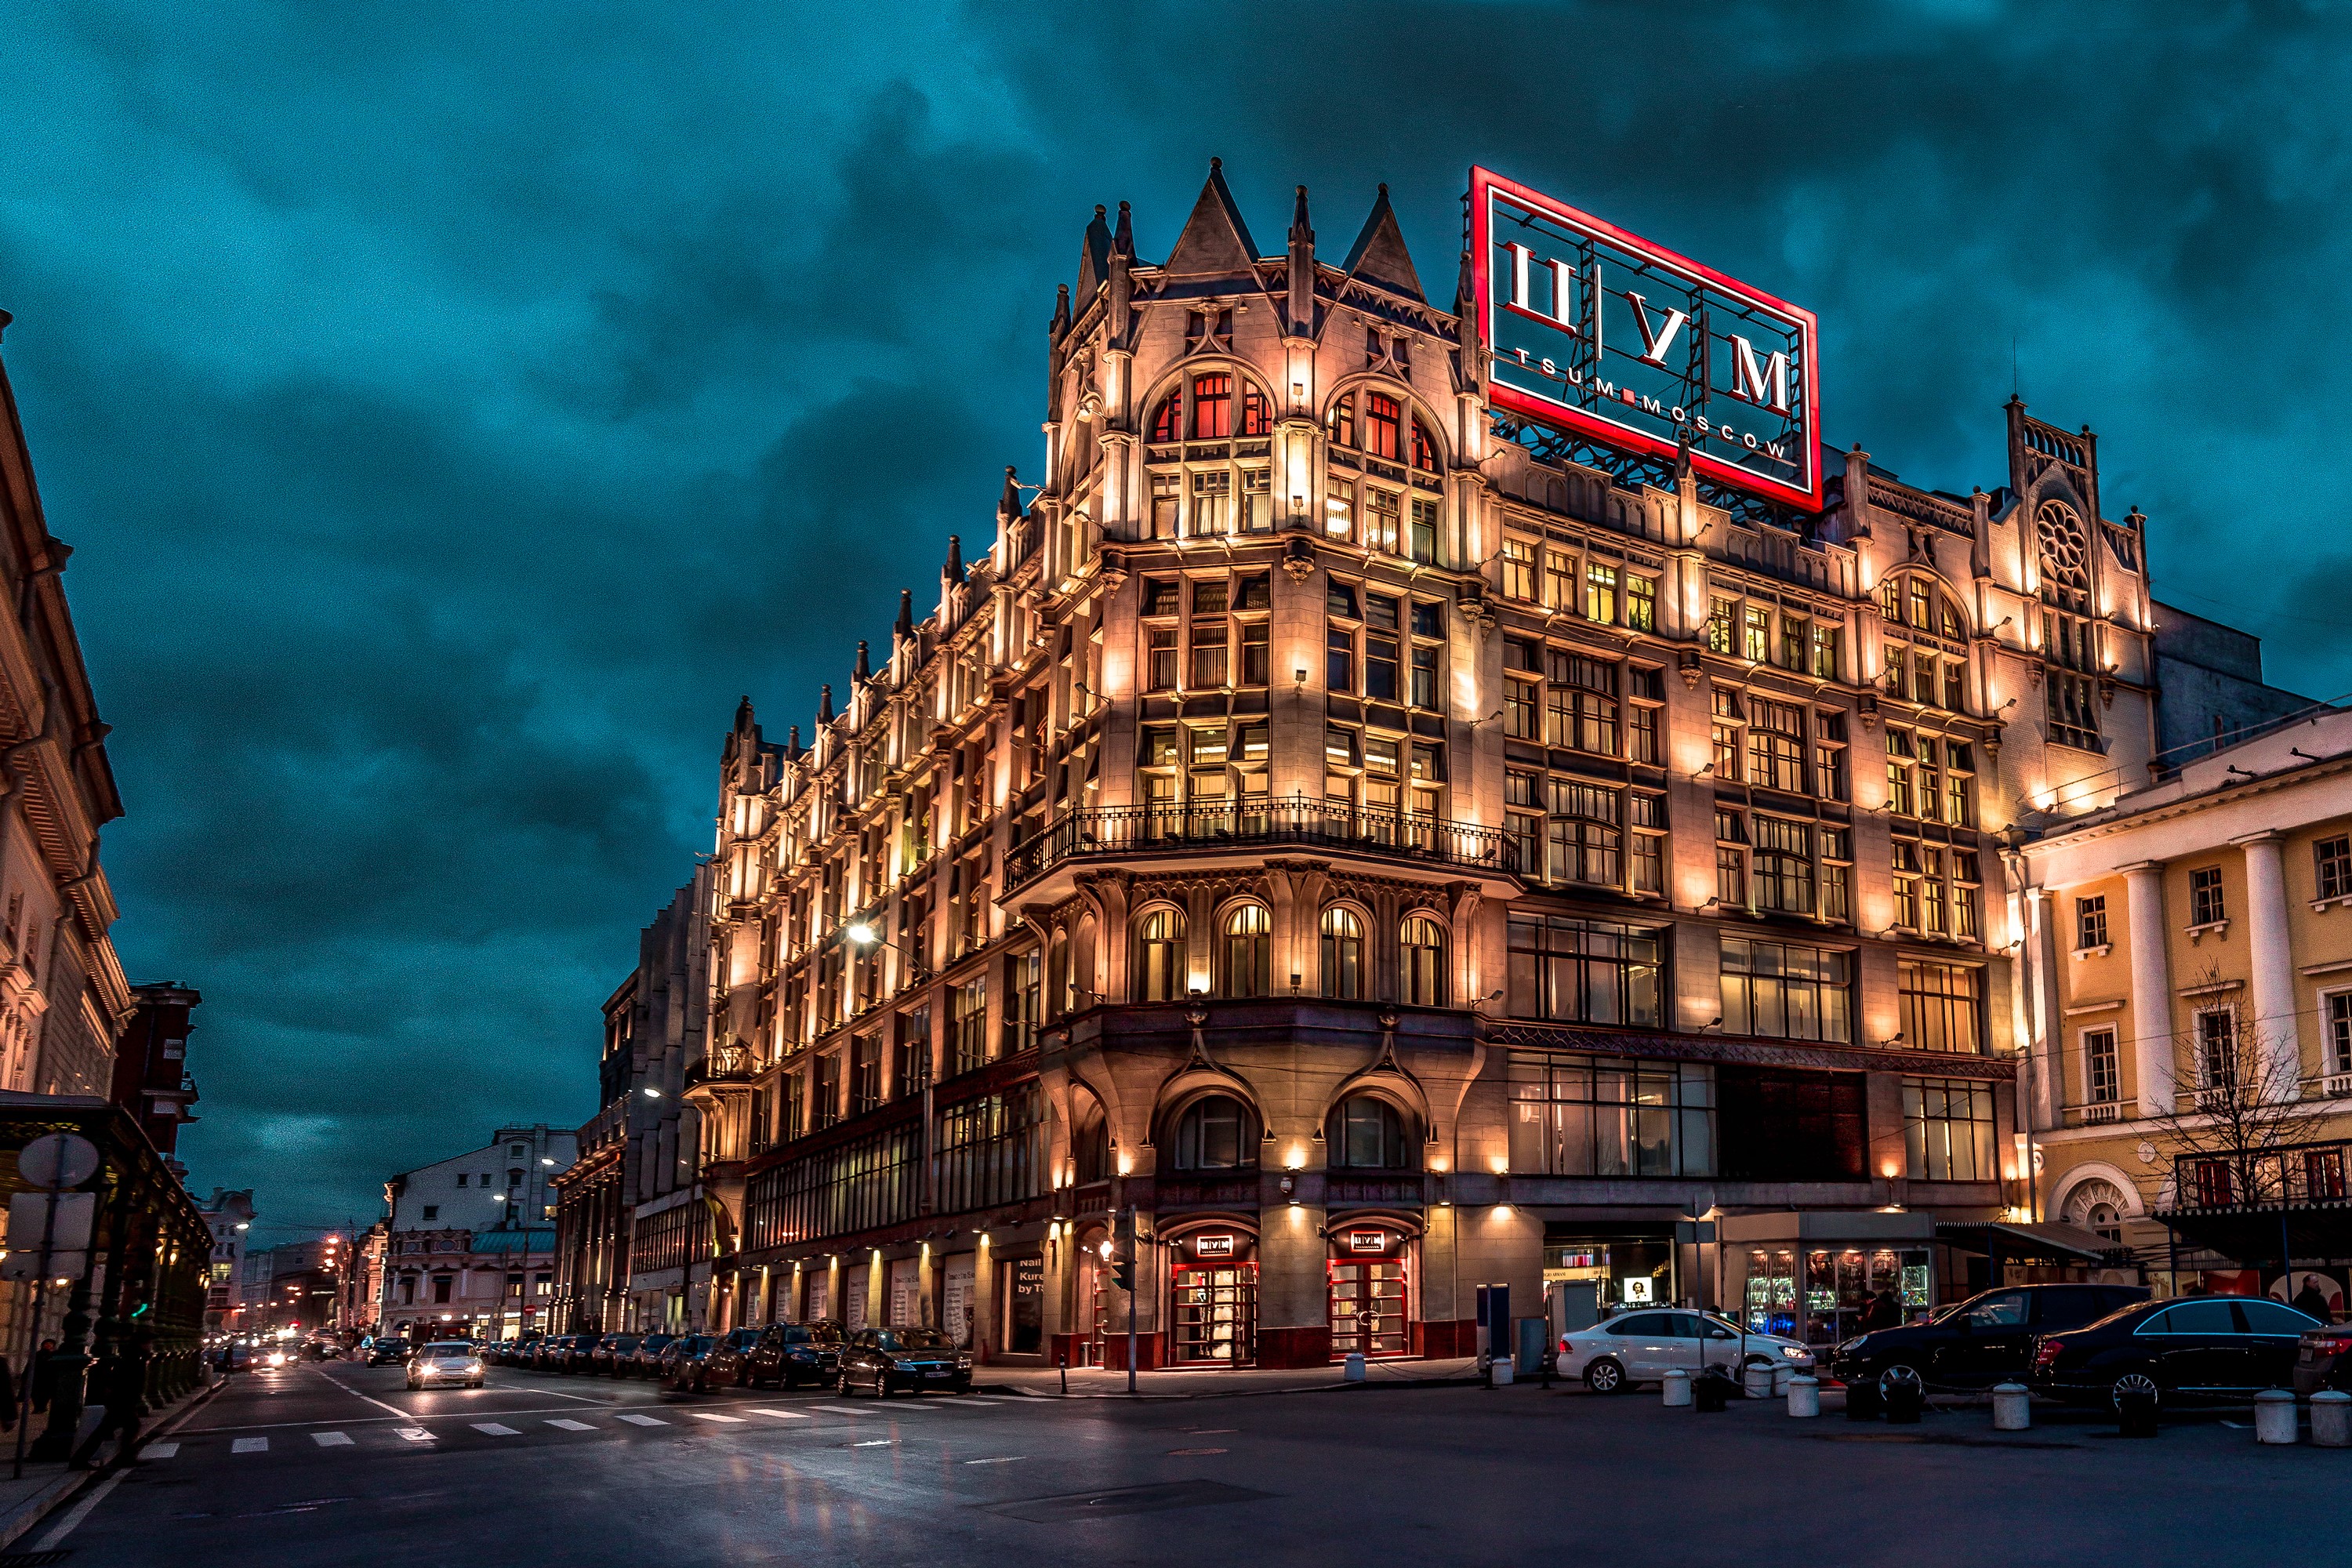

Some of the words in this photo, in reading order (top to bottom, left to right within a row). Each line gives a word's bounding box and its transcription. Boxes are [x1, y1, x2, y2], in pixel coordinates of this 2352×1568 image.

[1515, 347, 1614, 397] TSUM
[1642, 394, 1785, 460] MOSCOW
[1018, 1284, 1032, 1294] by
